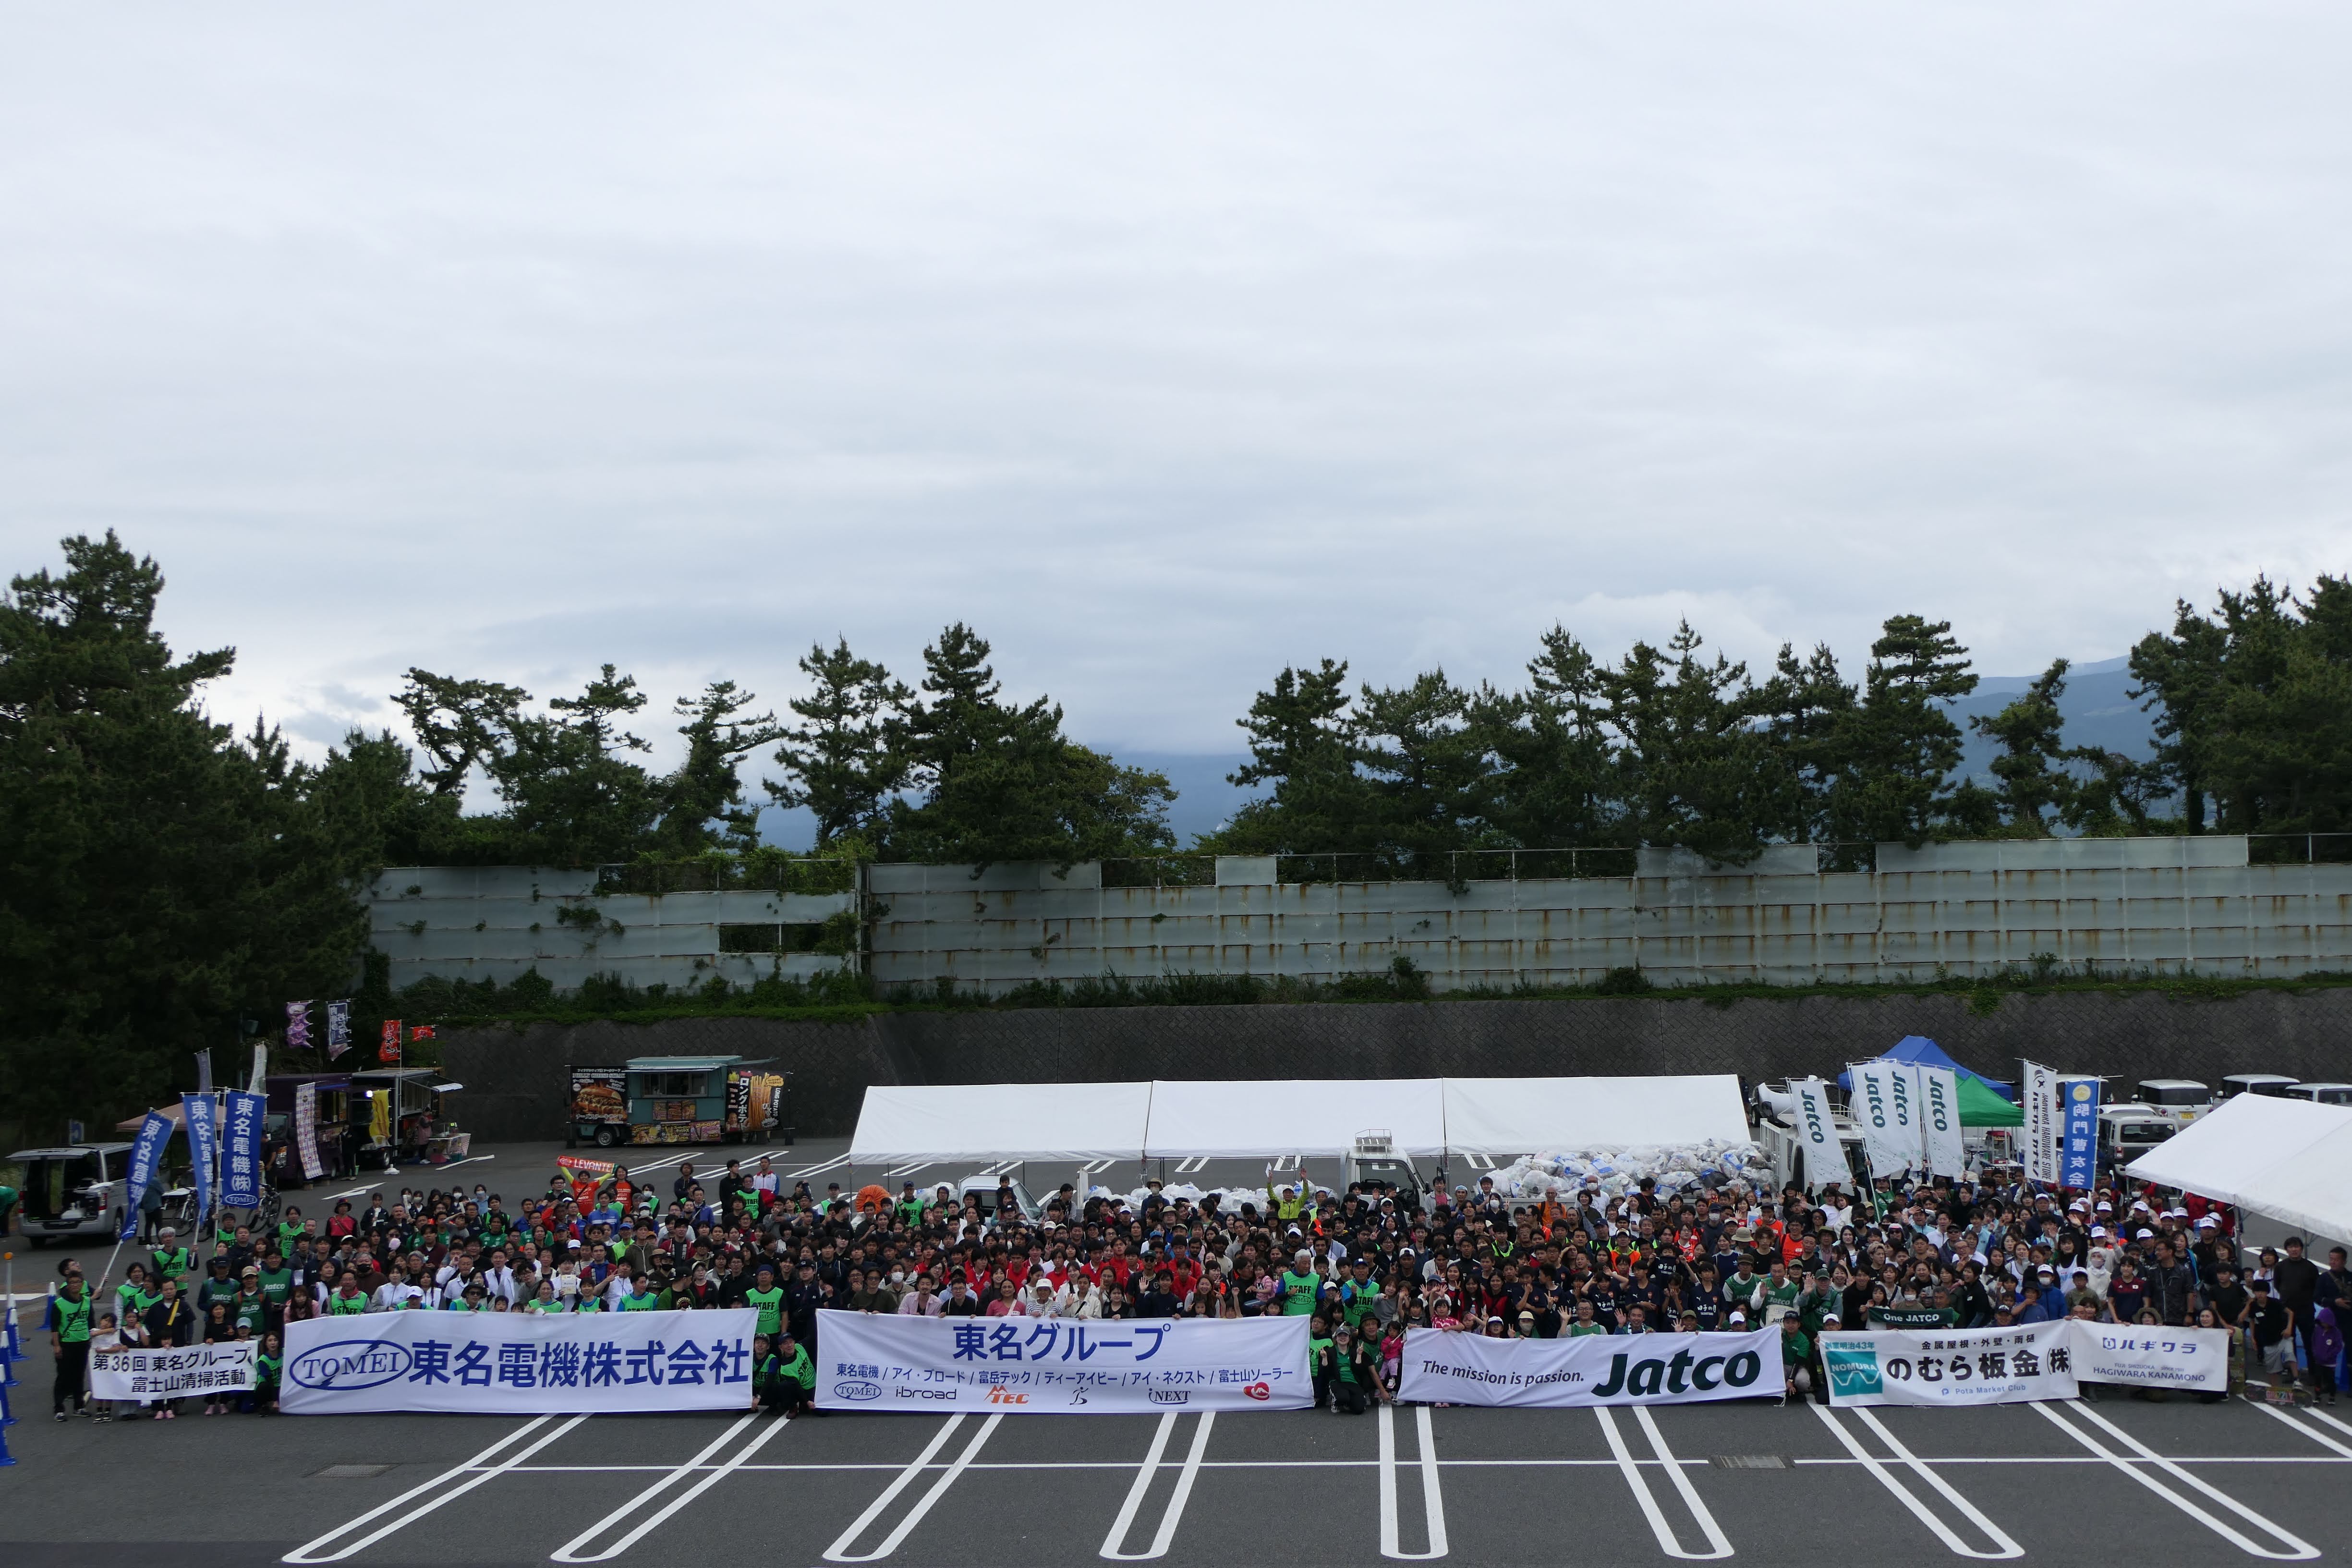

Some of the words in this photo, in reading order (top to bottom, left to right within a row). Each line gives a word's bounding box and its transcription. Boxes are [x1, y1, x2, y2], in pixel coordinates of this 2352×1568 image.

[1864, 1072, 1886, 1128] Jatco
[1929, 1075, 1948, 1131] Jatco
[1801, 1089, 1824, 1143] Jatco
[2042, 1127, 2050, 1160] HARDWARE
[574, 1159, 612, 1173] LEVANTE
[2042, 1161, 2051, 1180] STORE
[757, 1302, 775, 1311] TAFF
[1768, 1297, 1790, 1305] Jatco
[1883, 1313, 1903, 1322] One
[1905, 1313, 1940, 1322] JATCO
[952, 1322, 1171, 1361] 東名グループ
[2120, 1339, 2197, 1354] ハギワラ
[93, 1354, 146, 1373] 第36回
[152, 1347, 252, 1372] 東名グループ
[303, 1351, 400, 1379] TOMEI
[408, 1338, 750, 1388] 東名電機株式会社
[1831, 1362, 1878, 1372] NOMURA
[132, 1368, 246, 1393] 富士山清掃活動
[837, 1363, 879, 1378] 東名電機
[1219, 1367, 1293, 1383] 富士山ソーラー
[1423, 1360, 1448, 1375] The
[1452, 1366, 1506, 1385] mission
[1510, 1372, 1521, 1385] is
[1525, 1369, 1584, 1387] passion.
[1591, 1348, 1761, 1397] Jatco
[2093, 1367, 2146, 1378] HAGIWARA
[2148, 1372, 2206, 1382] KANAMONO
[839, 1385, 878, 1397] TOMEI
[991, 1393, 1030, 1404] TEC
